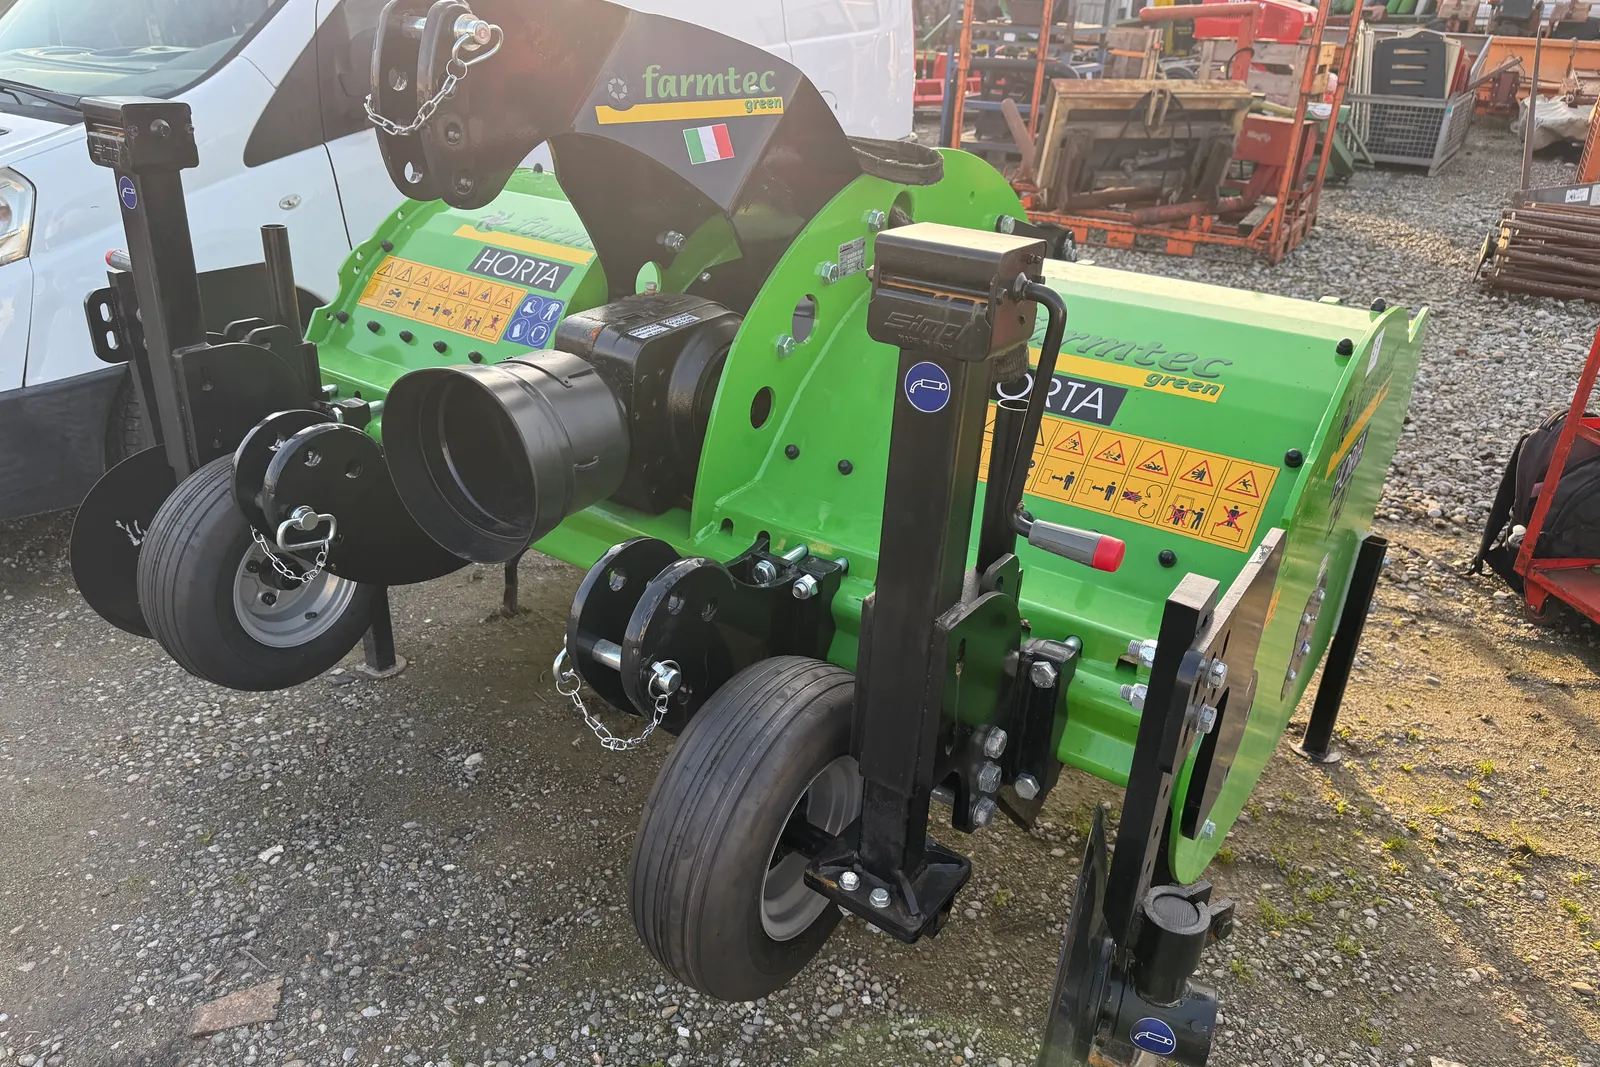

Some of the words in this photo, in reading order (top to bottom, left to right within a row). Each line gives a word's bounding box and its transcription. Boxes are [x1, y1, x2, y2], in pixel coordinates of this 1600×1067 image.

[642, 64, 776, 98] farmtec
[744, 98, 782, 113] green
[474, 249, 560, 289] HORTA
[996, 373, 1104, 420] ORTA
[1143, 373, 1220, 397] green
